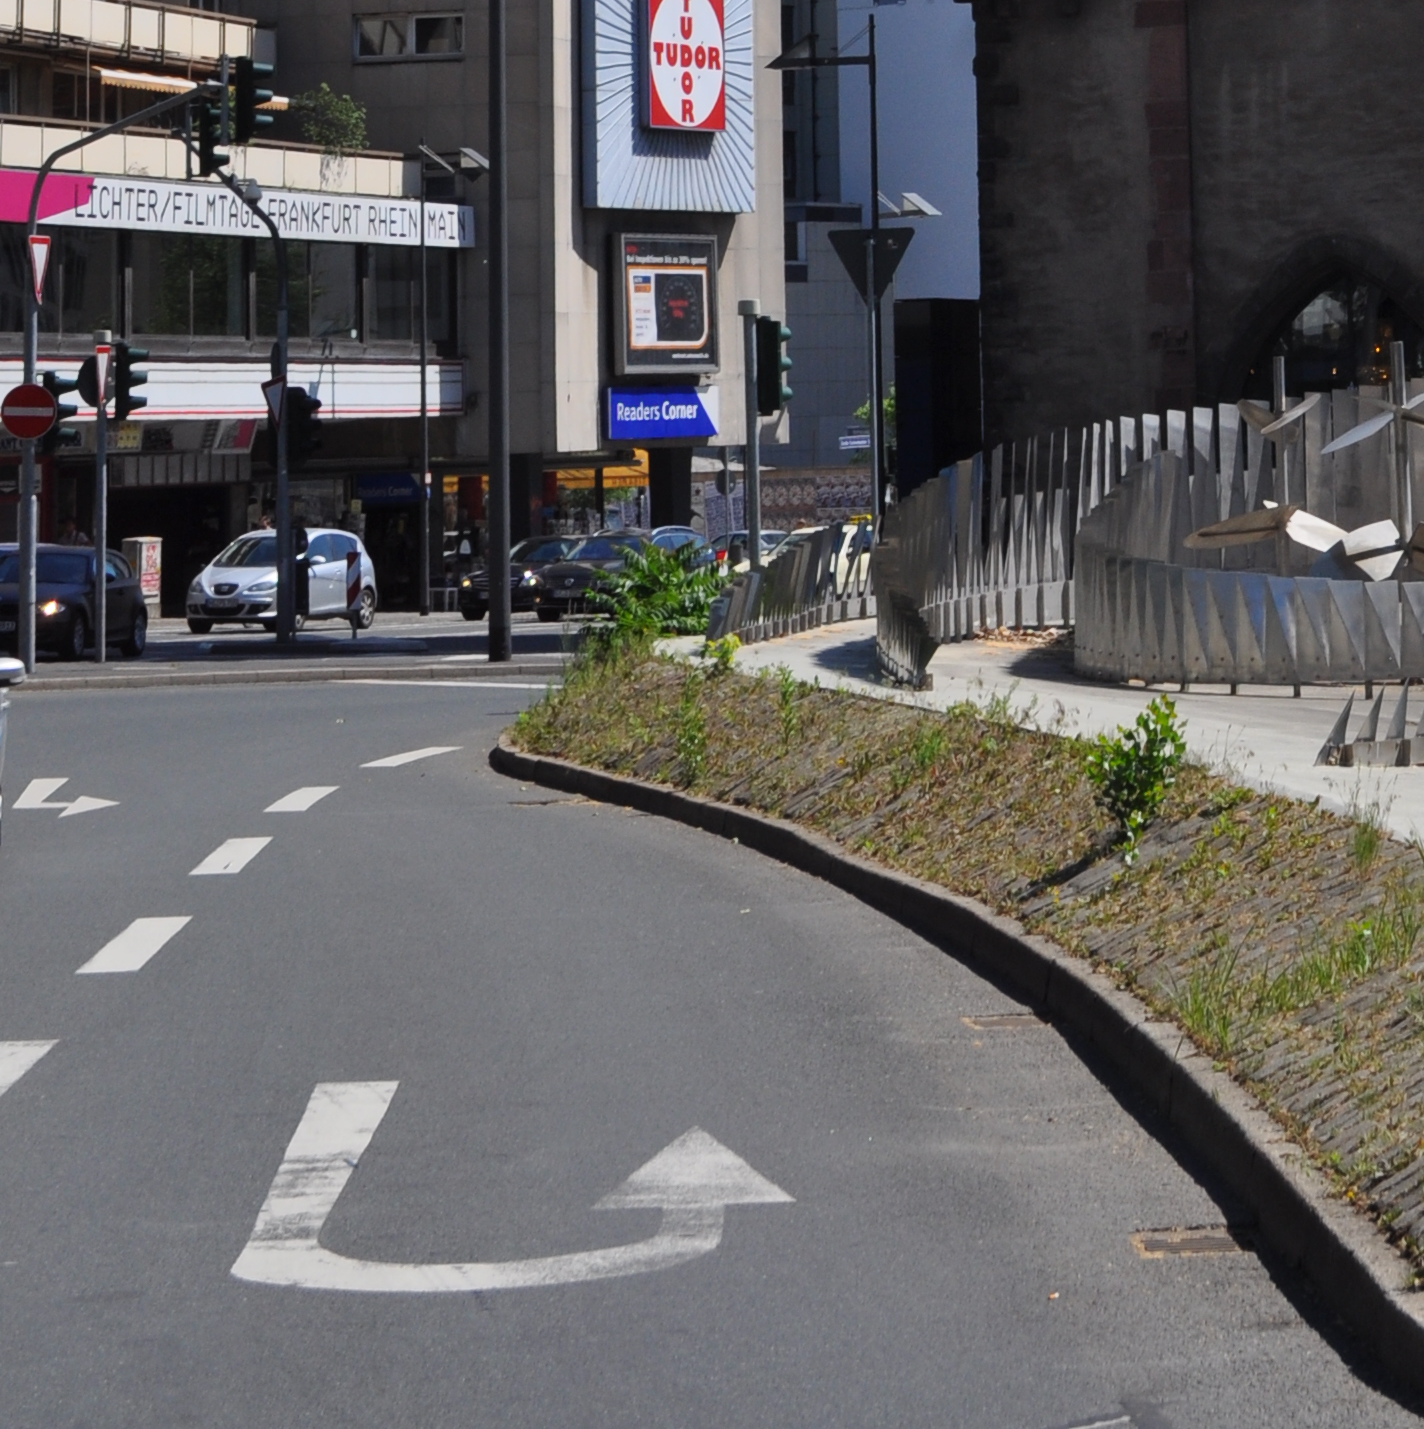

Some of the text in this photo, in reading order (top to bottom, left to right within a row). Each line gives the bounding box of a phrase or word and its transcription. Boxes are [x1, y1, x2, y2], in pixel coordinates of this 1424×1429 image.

[653, 42, 721, 70] TUDOR
[267, 199, 361, 234] FRANKFURT
[368, 205, 418, 238] RHEIN
[427, 210, 466, 241] MAIN
[616, 401, 698, 421] Readers Corner
